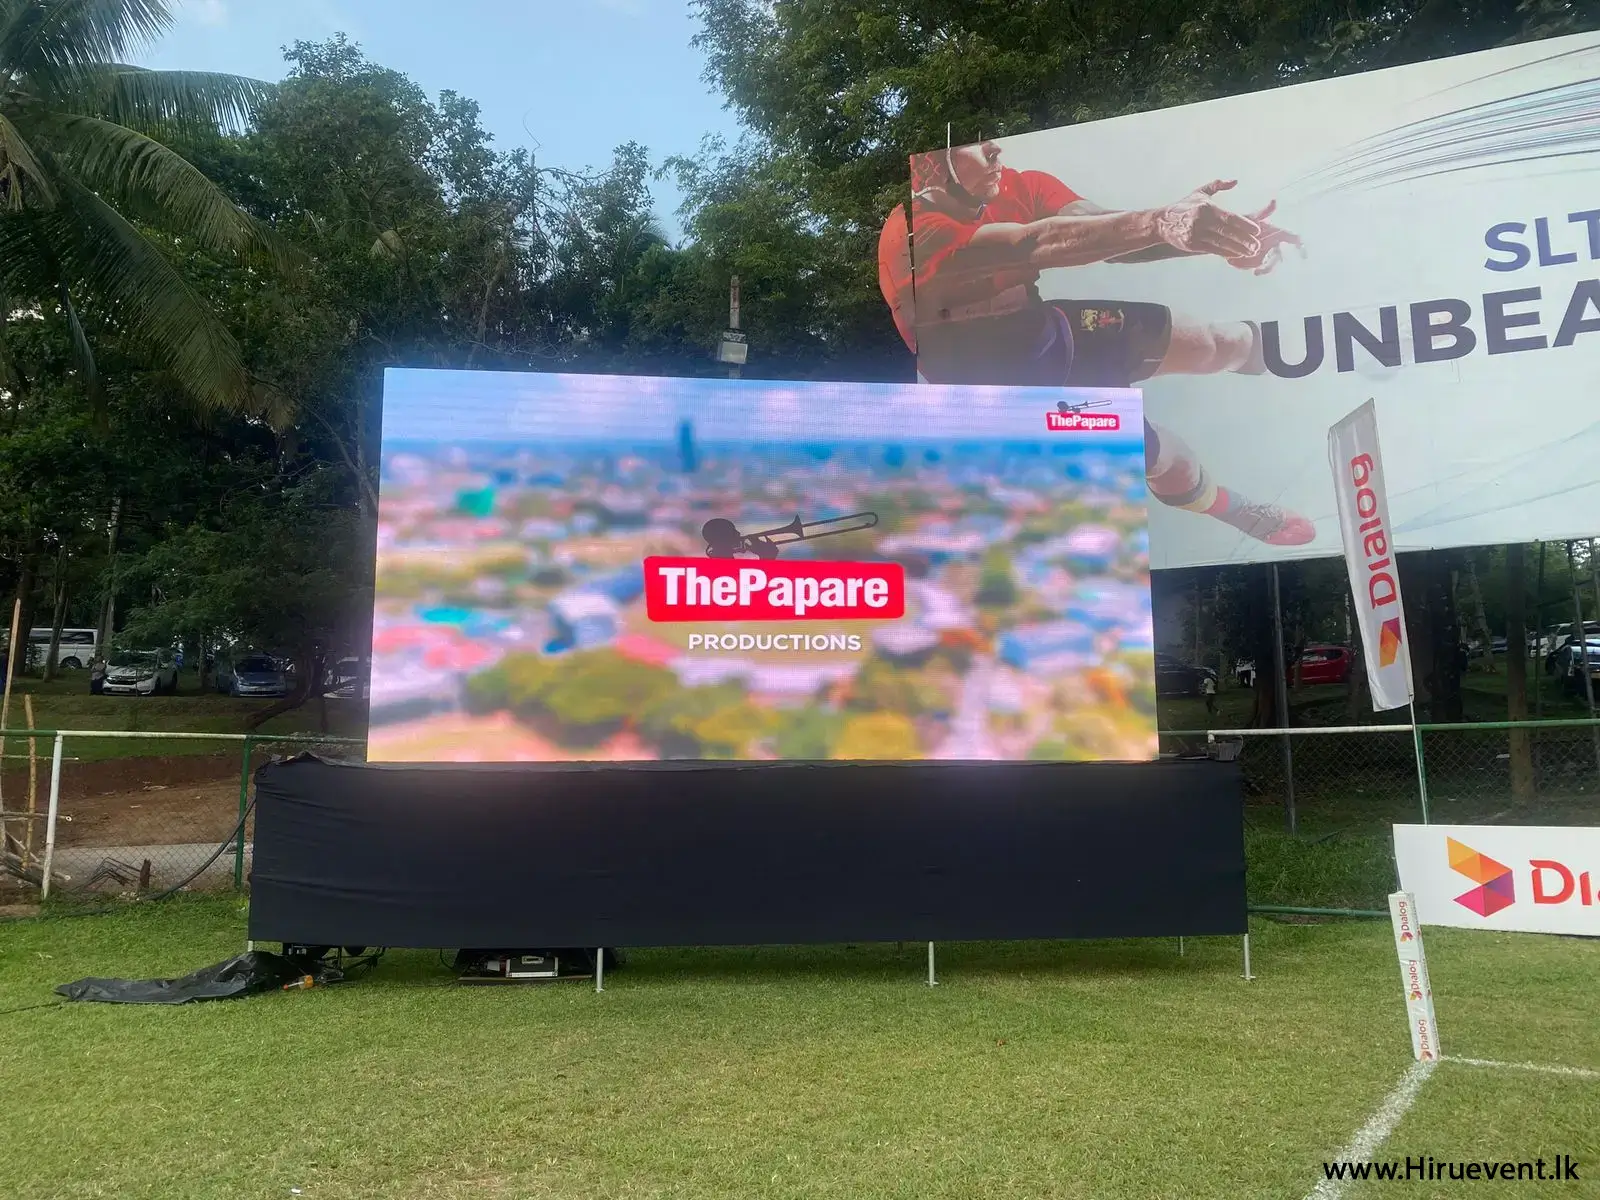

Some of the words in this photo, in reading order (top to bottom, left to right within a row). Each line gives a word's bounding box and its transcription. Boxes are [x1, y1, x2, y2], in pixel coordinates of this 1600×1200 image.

[1260, 278, 1600, 379] UNBEA
[1049, 414, 1116, 429] ThePapare
[1350, 452, 1398, 610] Dialog
[659, 567, 889, 616] ThePapare
[688, 633, 862, 651] PRODUCTIONS
[1529, 859, 1600, 906] Di
[1399, 901, 1410, 931] Dialog
